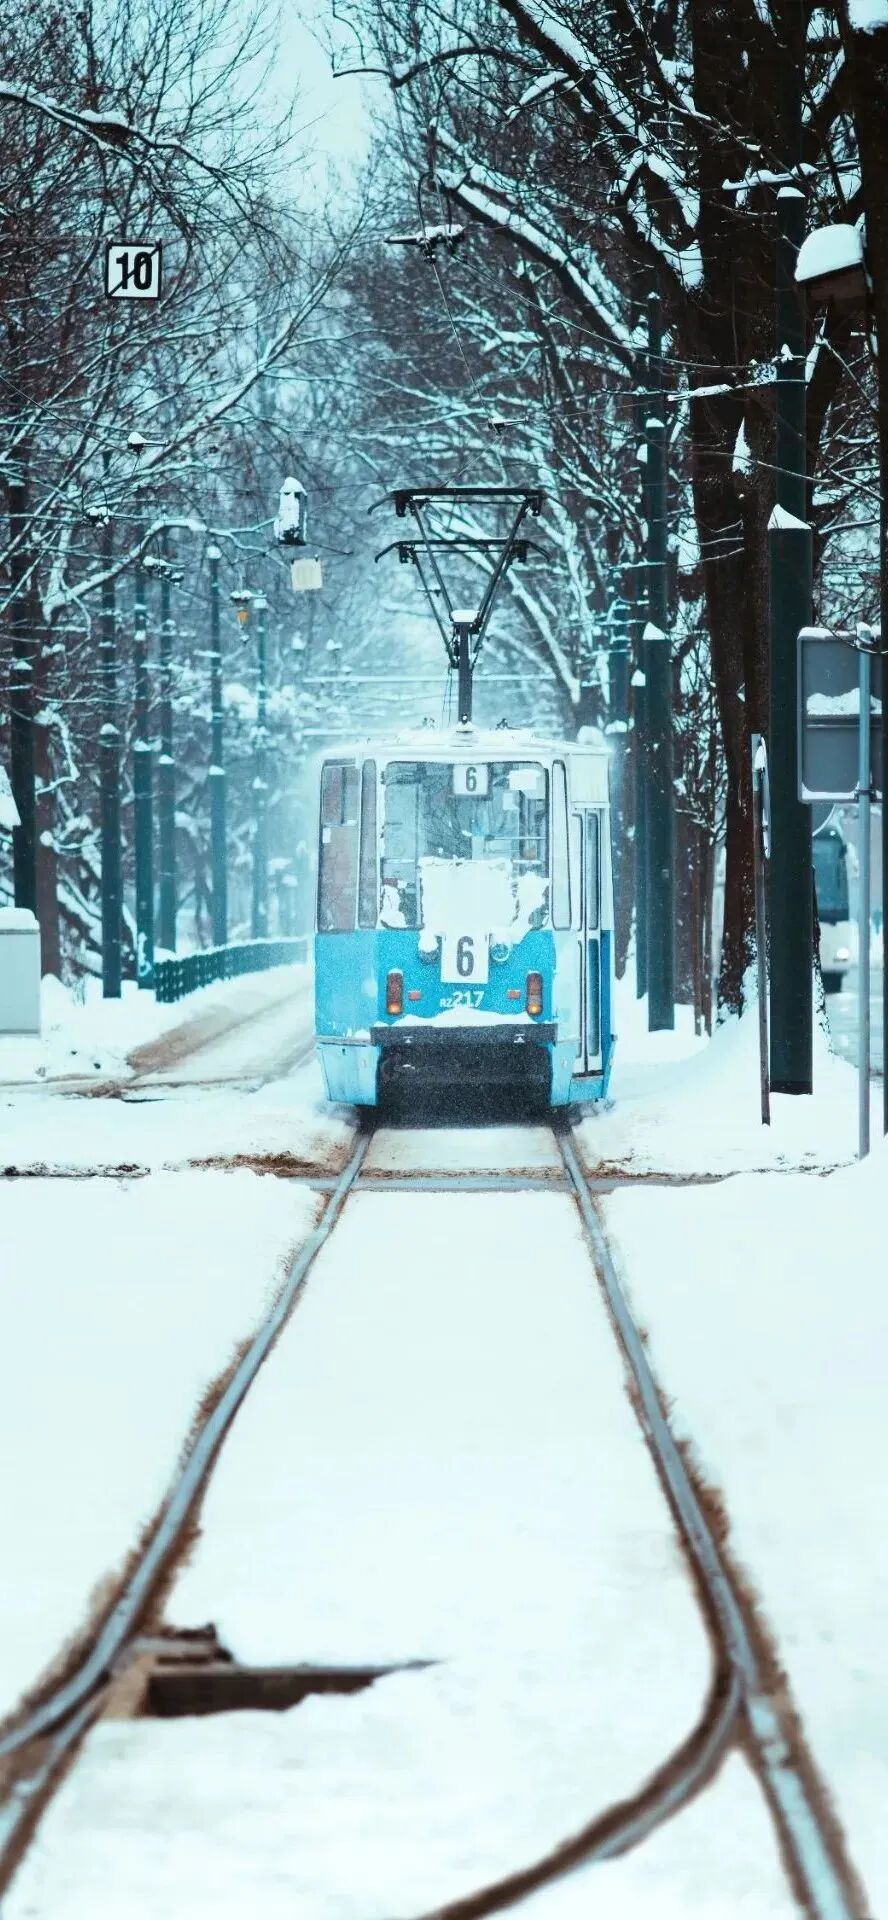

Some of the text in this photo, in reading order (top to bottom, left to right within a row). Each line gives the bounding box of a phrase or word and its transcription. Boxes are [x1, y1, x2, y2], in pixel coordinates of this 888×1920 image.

[116, 252, 152, 290] 10
[465, 766, 477, 792] 6
[456, 936, 475, 977] 6
